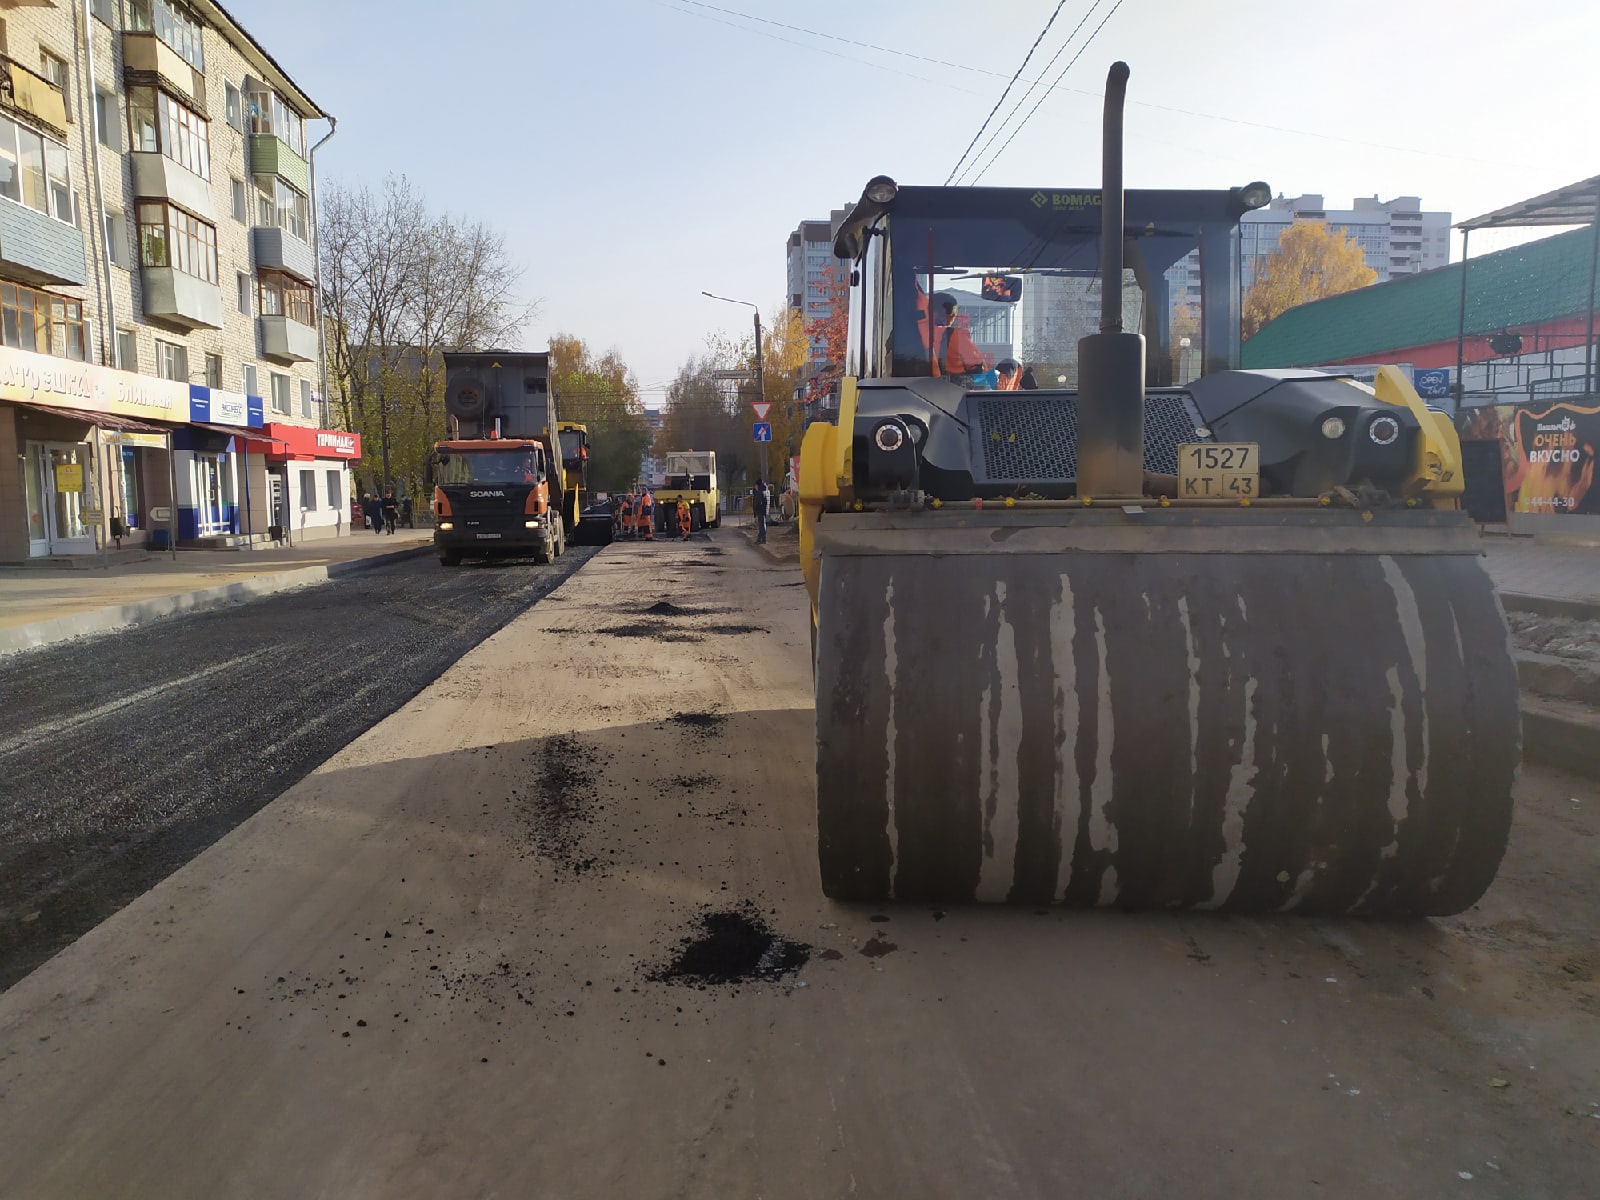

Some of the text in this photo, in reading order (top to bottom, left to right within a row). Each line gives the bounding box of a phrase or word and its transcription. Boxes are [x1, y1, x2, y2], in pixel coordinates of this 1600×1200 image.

[1052, 194, 1102, 206] BOMAG
[0, 361, 91, 399] атрешка
[1534, 433, 1576, 447] ОЧЕНЬ
[1190, 448, 1249, 469] 1527
[1529, 449, 1580, 463] ВКУСНО
[1185, 477, 1252, 495] КТ 43
[1531, 496, 1575, 507] 44-44-30
